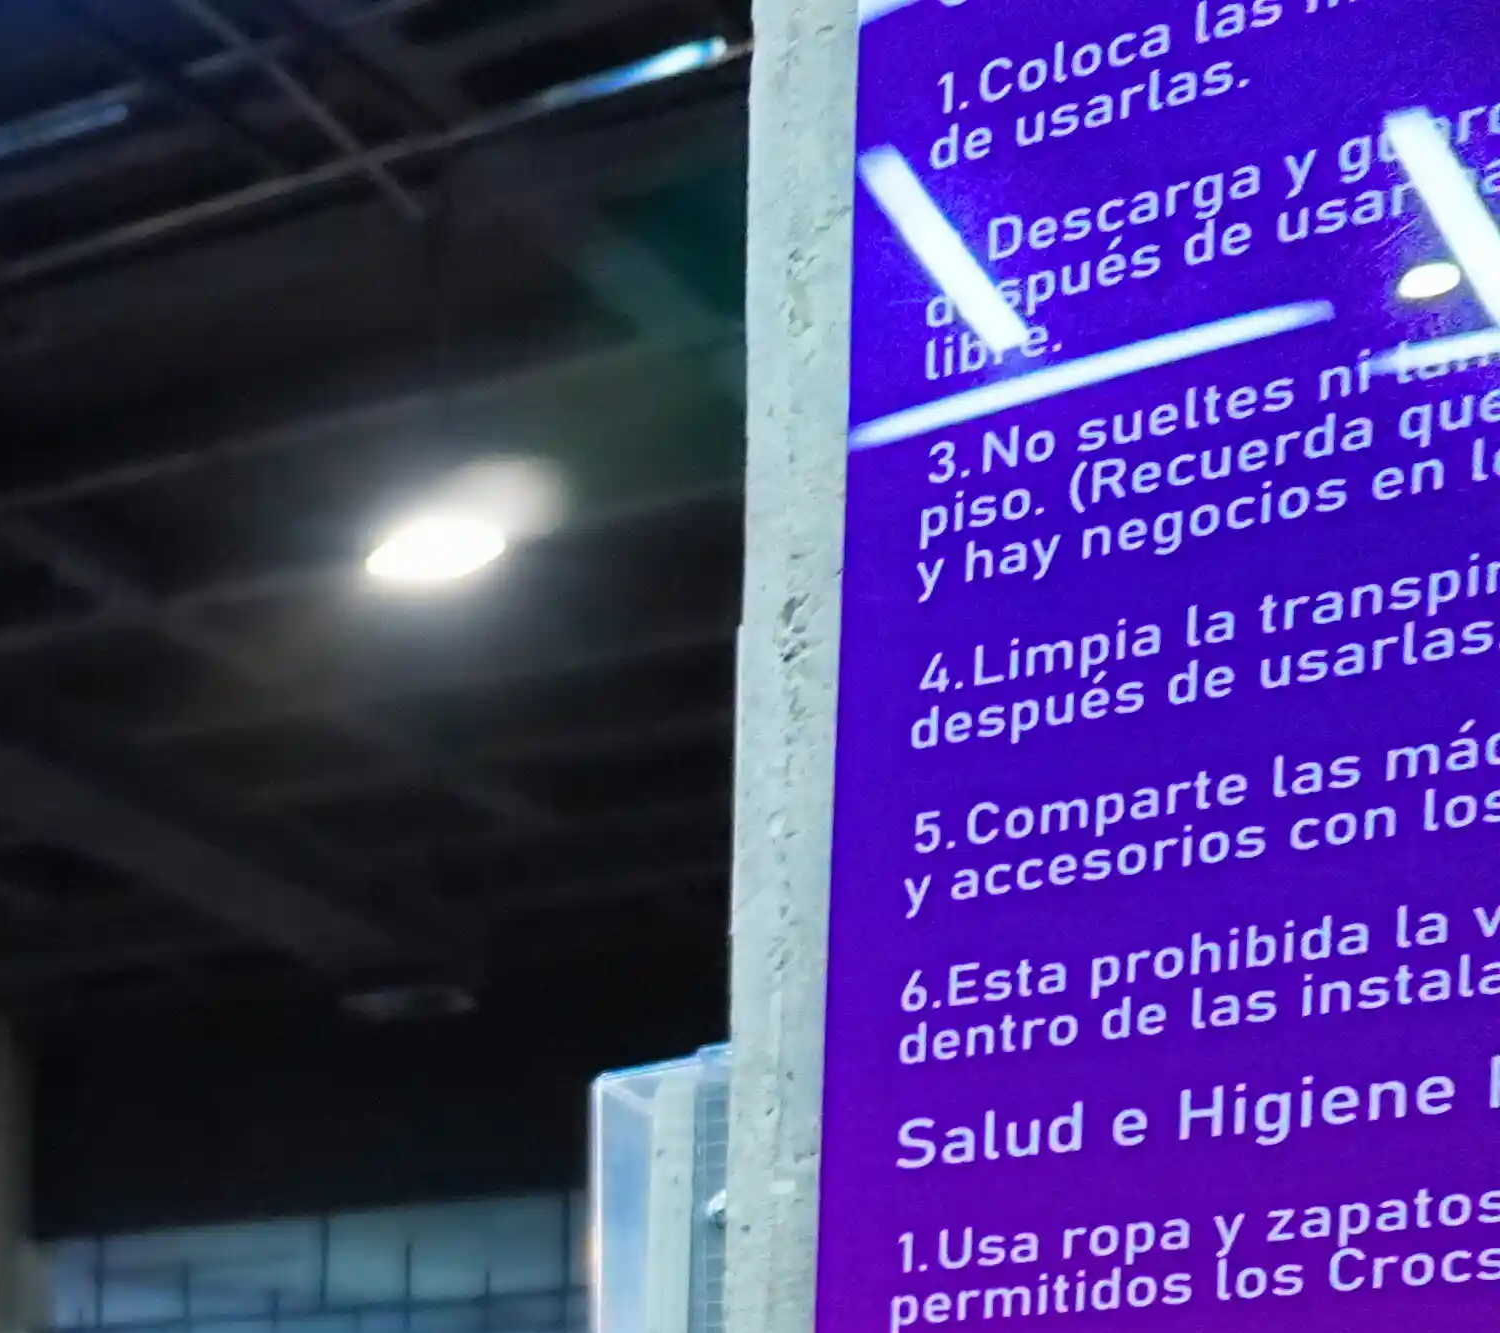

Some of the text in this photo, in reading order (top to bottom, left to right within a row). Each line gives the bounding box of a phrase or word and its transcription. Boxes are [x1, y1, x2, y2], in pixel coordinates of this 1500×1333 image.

[929, 61, 1249, 169] de usarlas.
[988, 165, 1260, 261] Descarga
[1284, 149, 1316, 199] y
[926, 235, 1160, 328] dspués
[1184, 219, 1252, 265] de
[1077, 378, 1294, 451] sueltes
[1319, 348, 1373, 402] ni
[920, 489, 1044, 549] piso.
[1069, 413, 1373, 513] (Recuerda
[917, 558, 944, 603] y
[965, 535, 1061, 582] hay
[1082, 479, 1346, 559] negocios
[1372, 459, 1444, 500] en
[1187, 605, 1234, 646] la
[911, 670, 1144, 749] después
[1168, 660, 1235, 705] de
[1273, 755, 1360, 797] las
[904, 875, 931, 918] y
[951, 825, 1265, 900] accesorios
[1290, 806, 1396, 850] con
[1091, 915, 1369, 999] prohibida
[1396, 905, 1448, 948] la
[899, 1015, 1078, 1064] dentro
[1102, 996, 1166, 1039] de
[1192, 988, 1276, 1029] las
[897, 1101, 1083, 1168] Salud
[1113, 1108, 1147, 1146] e
[1179, 1076, 1455, 1145] Higiene
[1063, 1219, 1190, 1265] ropa
[1214, 1213, 1245, 1259] y
[1216, 1257, 1304, 1300] los
[1329, 1248, 1500, 1291] Crocs
